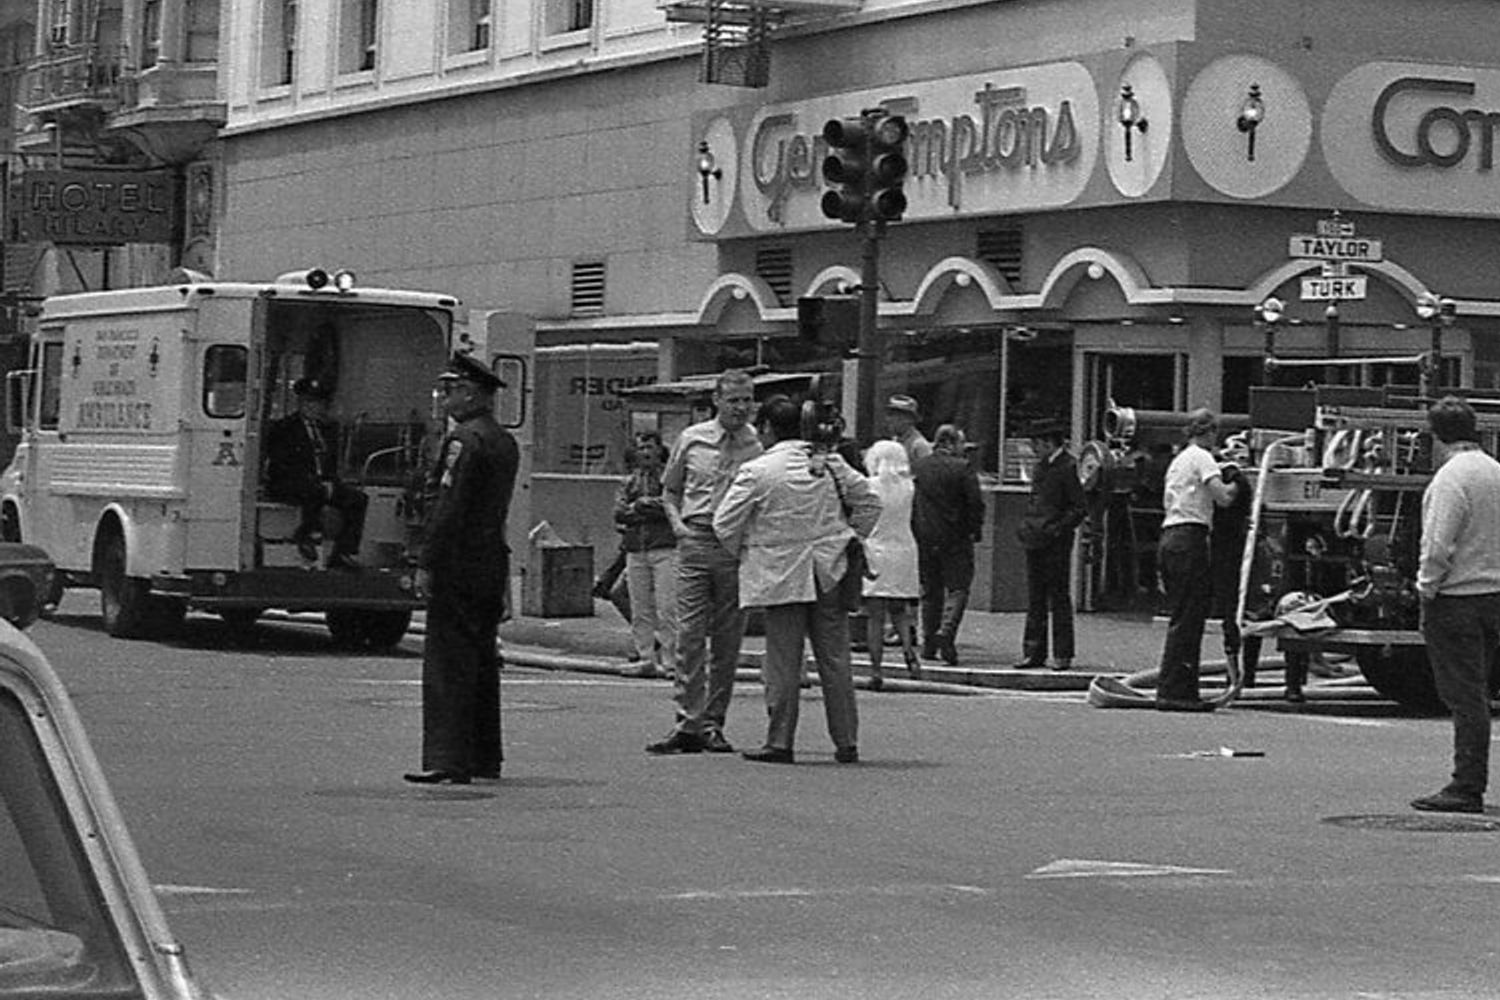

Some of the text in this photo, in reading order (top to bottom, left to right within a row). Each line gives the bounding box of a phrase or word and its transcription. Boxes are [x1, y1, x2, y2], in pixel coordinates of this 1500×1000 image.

[32, 182, 165, 212] HOTEL
[1302, 239, 1369, 256] TAYLOR
[1310, 281, 1355, 297] TURK
[212, 442, 239, 466] A
